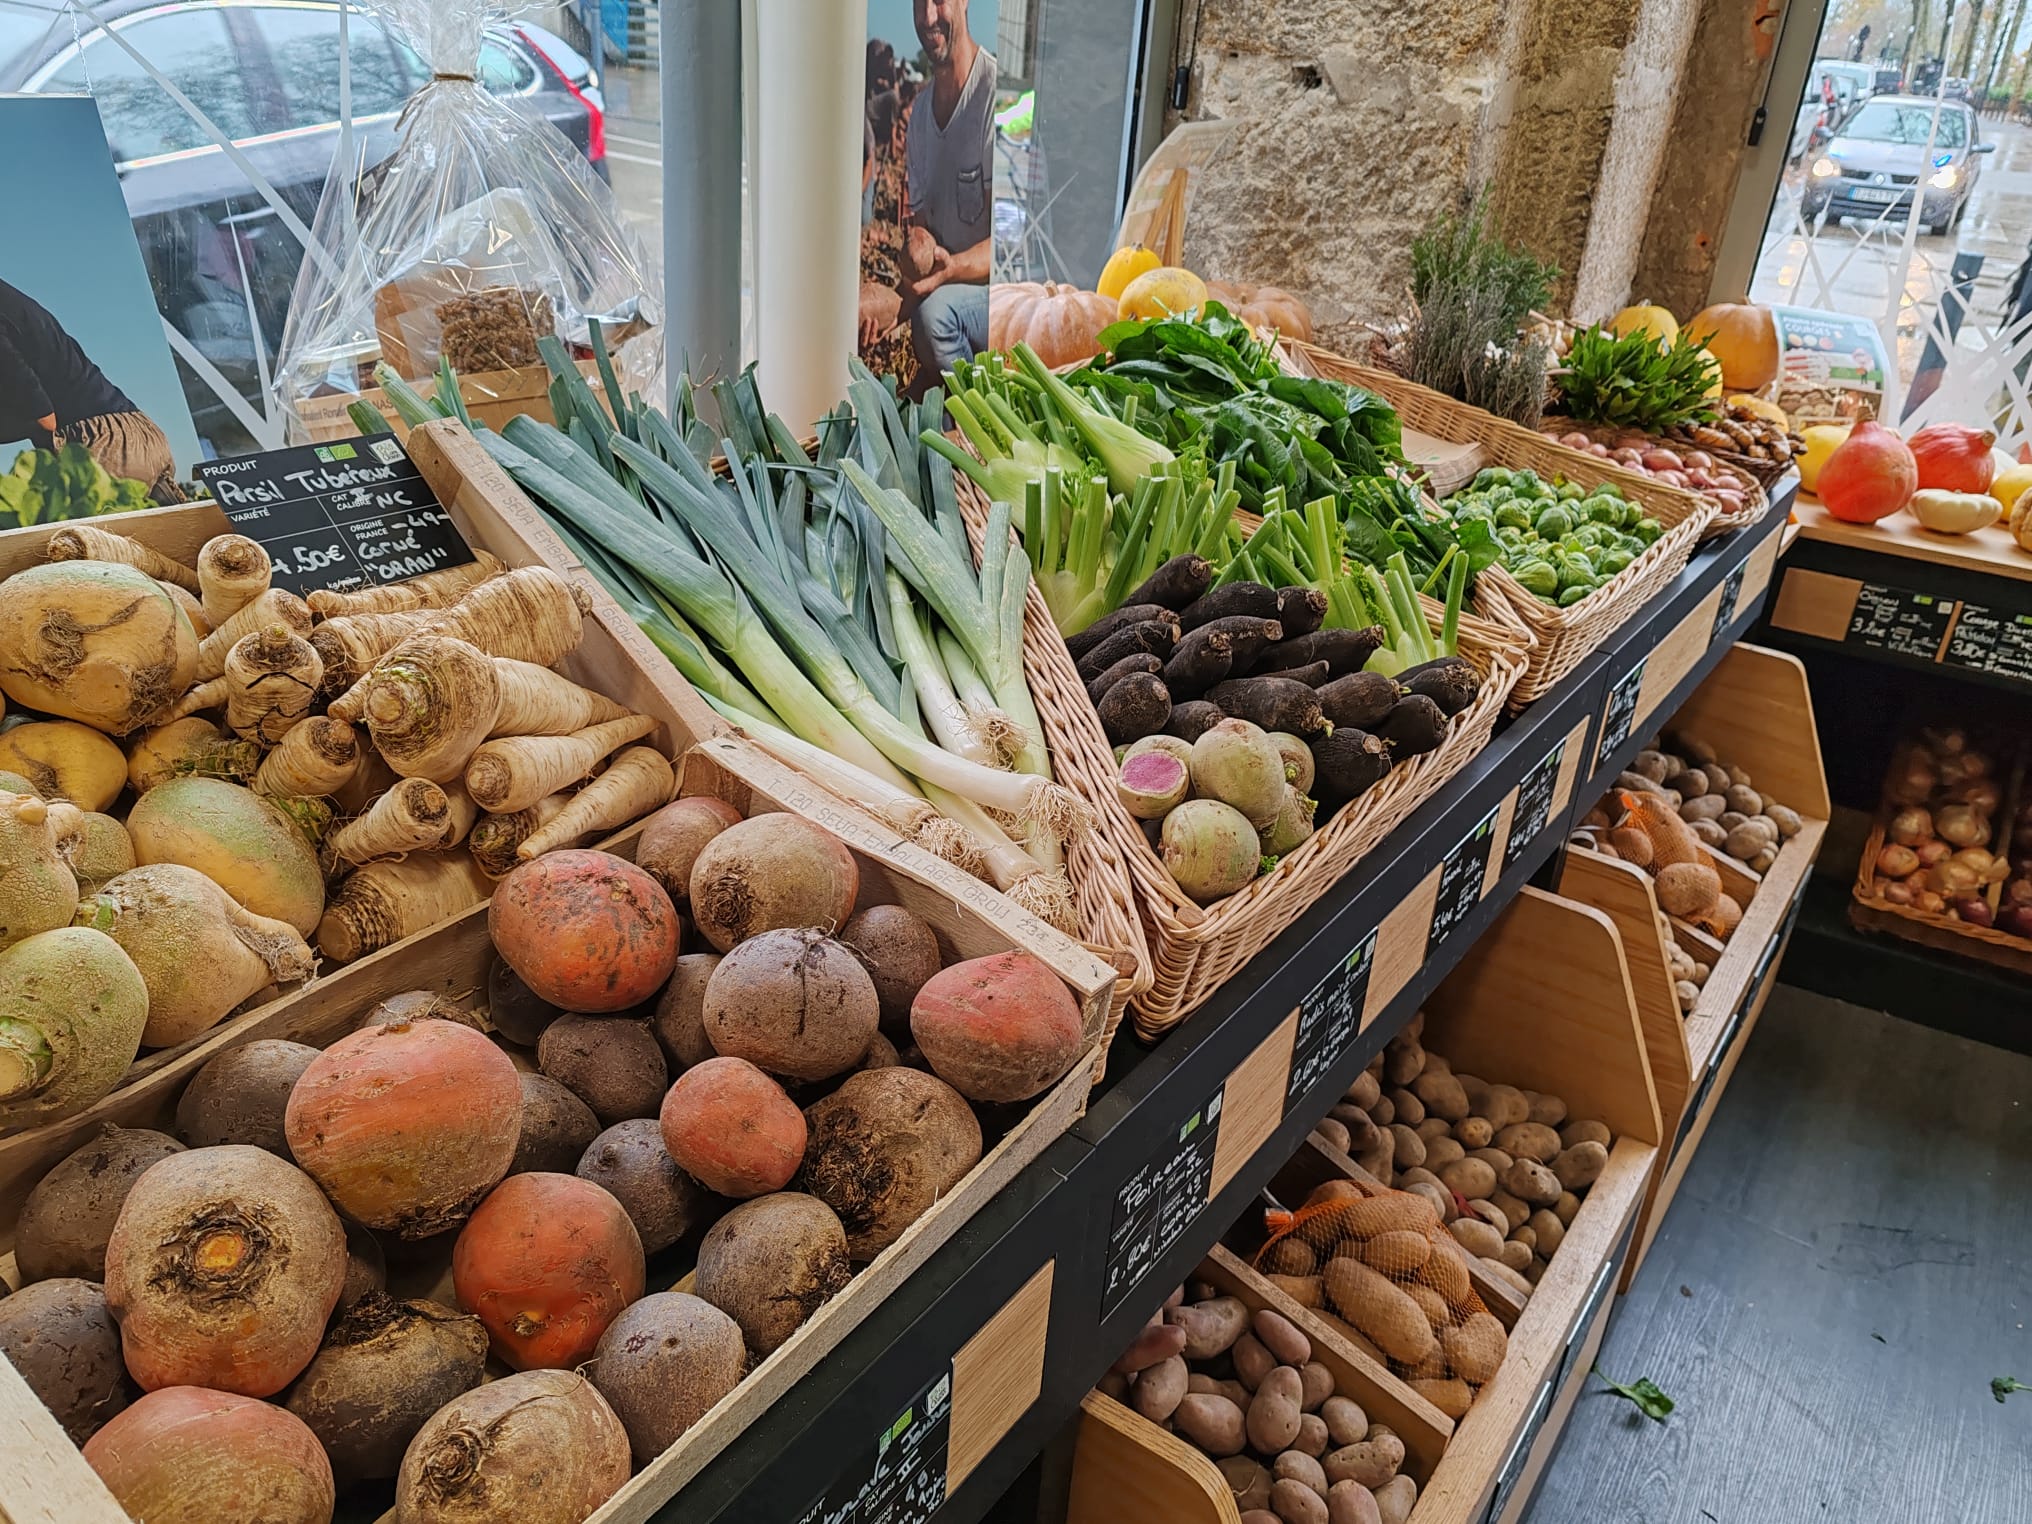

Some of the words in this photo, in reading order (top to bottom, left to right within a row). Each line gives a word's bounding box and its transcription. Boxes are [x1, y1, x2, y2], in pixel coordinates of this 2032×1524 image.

[202, 460, 257, 477] PRODUIT
[283, 463, 397, 493] Tubéreux
[331, 494, 347, 503] CAT
[336, 497, 372, 511] CALIBRE
[376, 490, 413, 509] NC
[480, 471, 506, 493] 120
[503, 495, 534, 526] SEVA
[230, 507, 271, 522] VARIÉTÉ
[350, 519, 384, 532] ORIGINE
[355, 527, 389, 541] FRANCE
[766, 778, 782, 792] T
[784, 789, 813, 811] 120
[816, 807, 858, 836] SEVA
[862, 833, 957, 885] EMBALLAGE
[1118, 1163, 1150, 1201] PRODUIT
[864, 1487, 881, 1508] CAT
